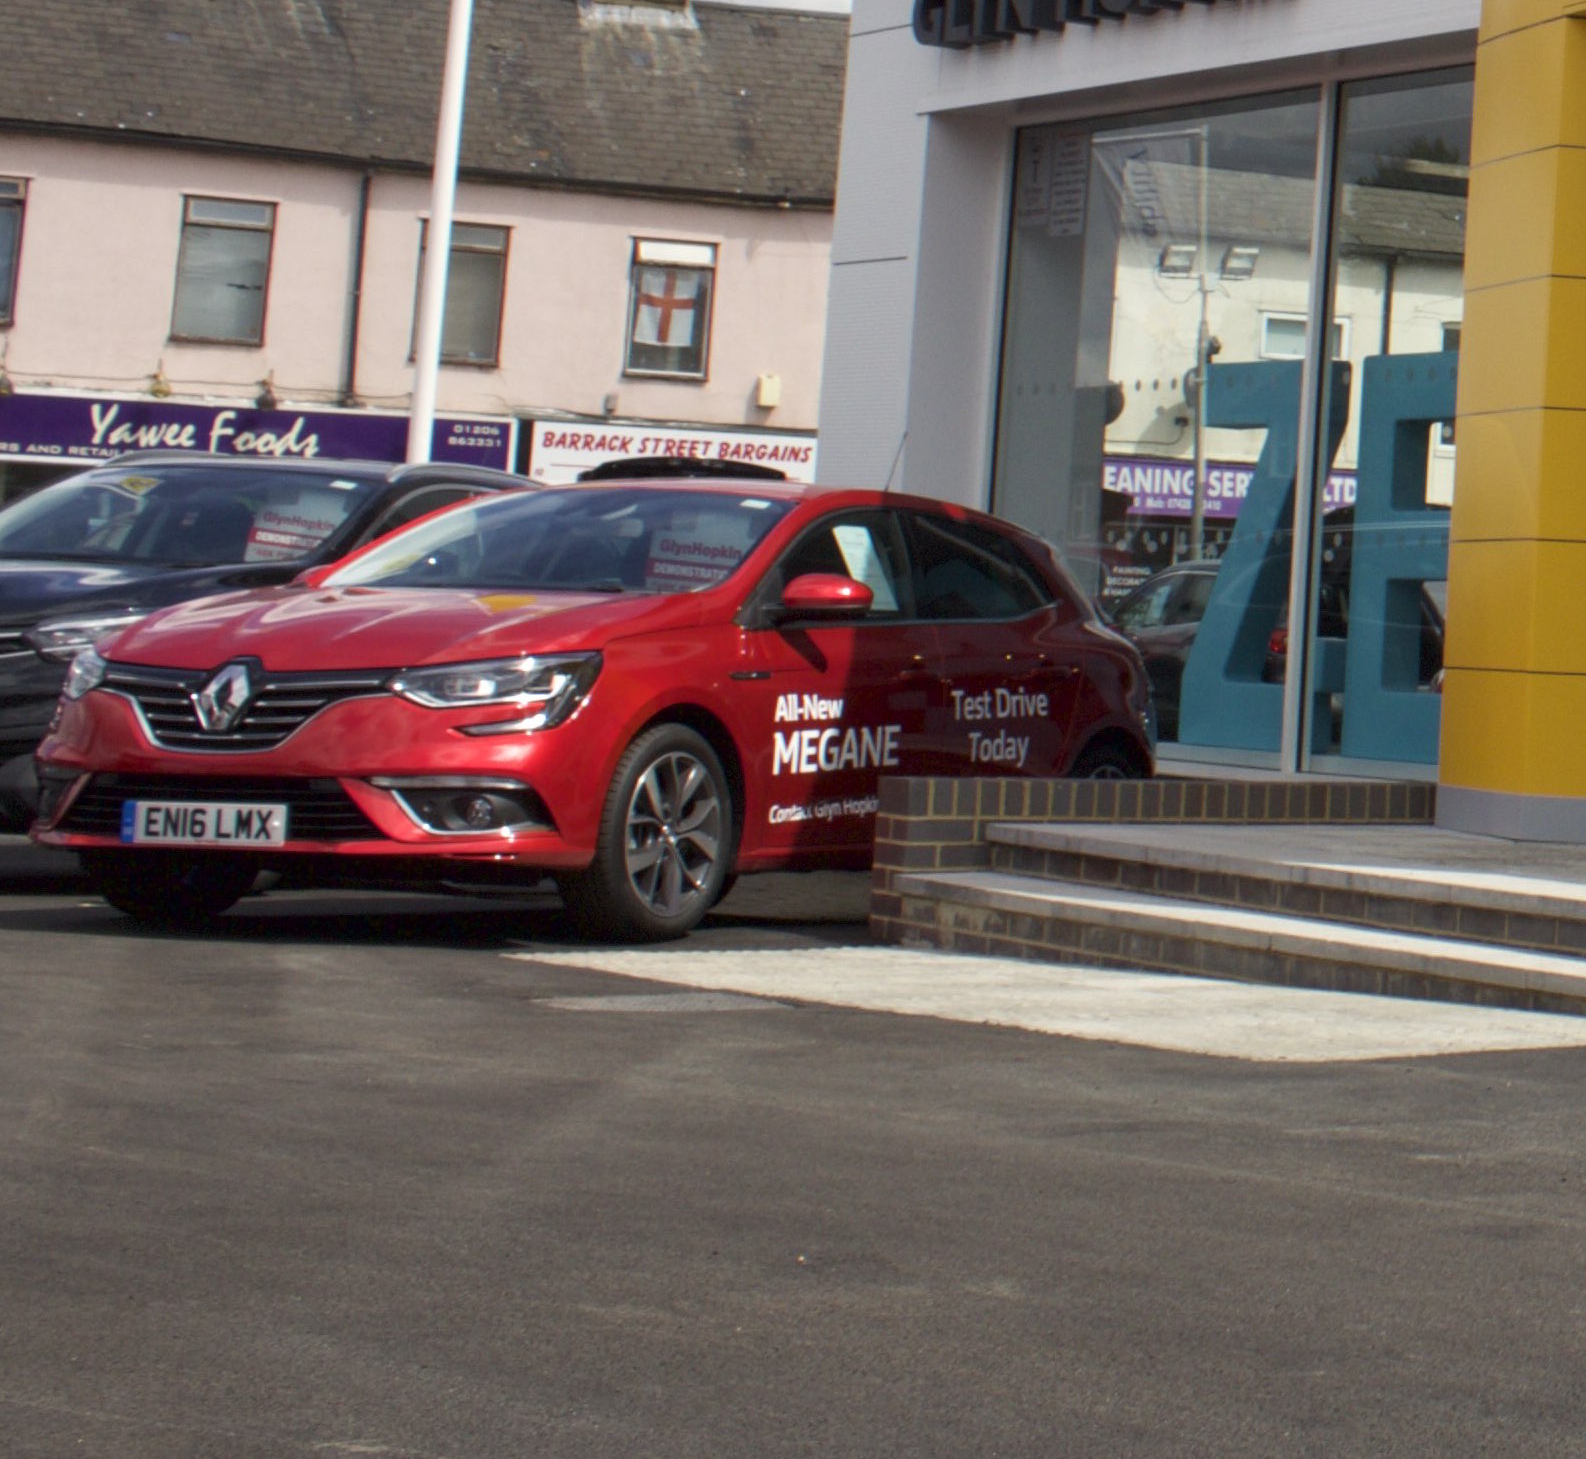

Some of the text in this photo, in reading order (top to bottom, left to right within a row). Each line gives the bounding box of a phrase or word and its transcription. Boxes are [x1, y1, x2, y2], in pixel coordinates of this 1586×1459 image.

[90, 403, 319, 457] Yawee Foods
[26, 444, 62, 455] AND
[542, 431, 813, 463] BARRACK STREET BARGAINS
[774, 694, 844, 722] All-New
[951, 687, 1048, 721] Test Drive
[772, 725, 902, 775] MEGANE
[968, 730, 1029, 768] Today
[144, 807, 273, 839] EN16 LMX
